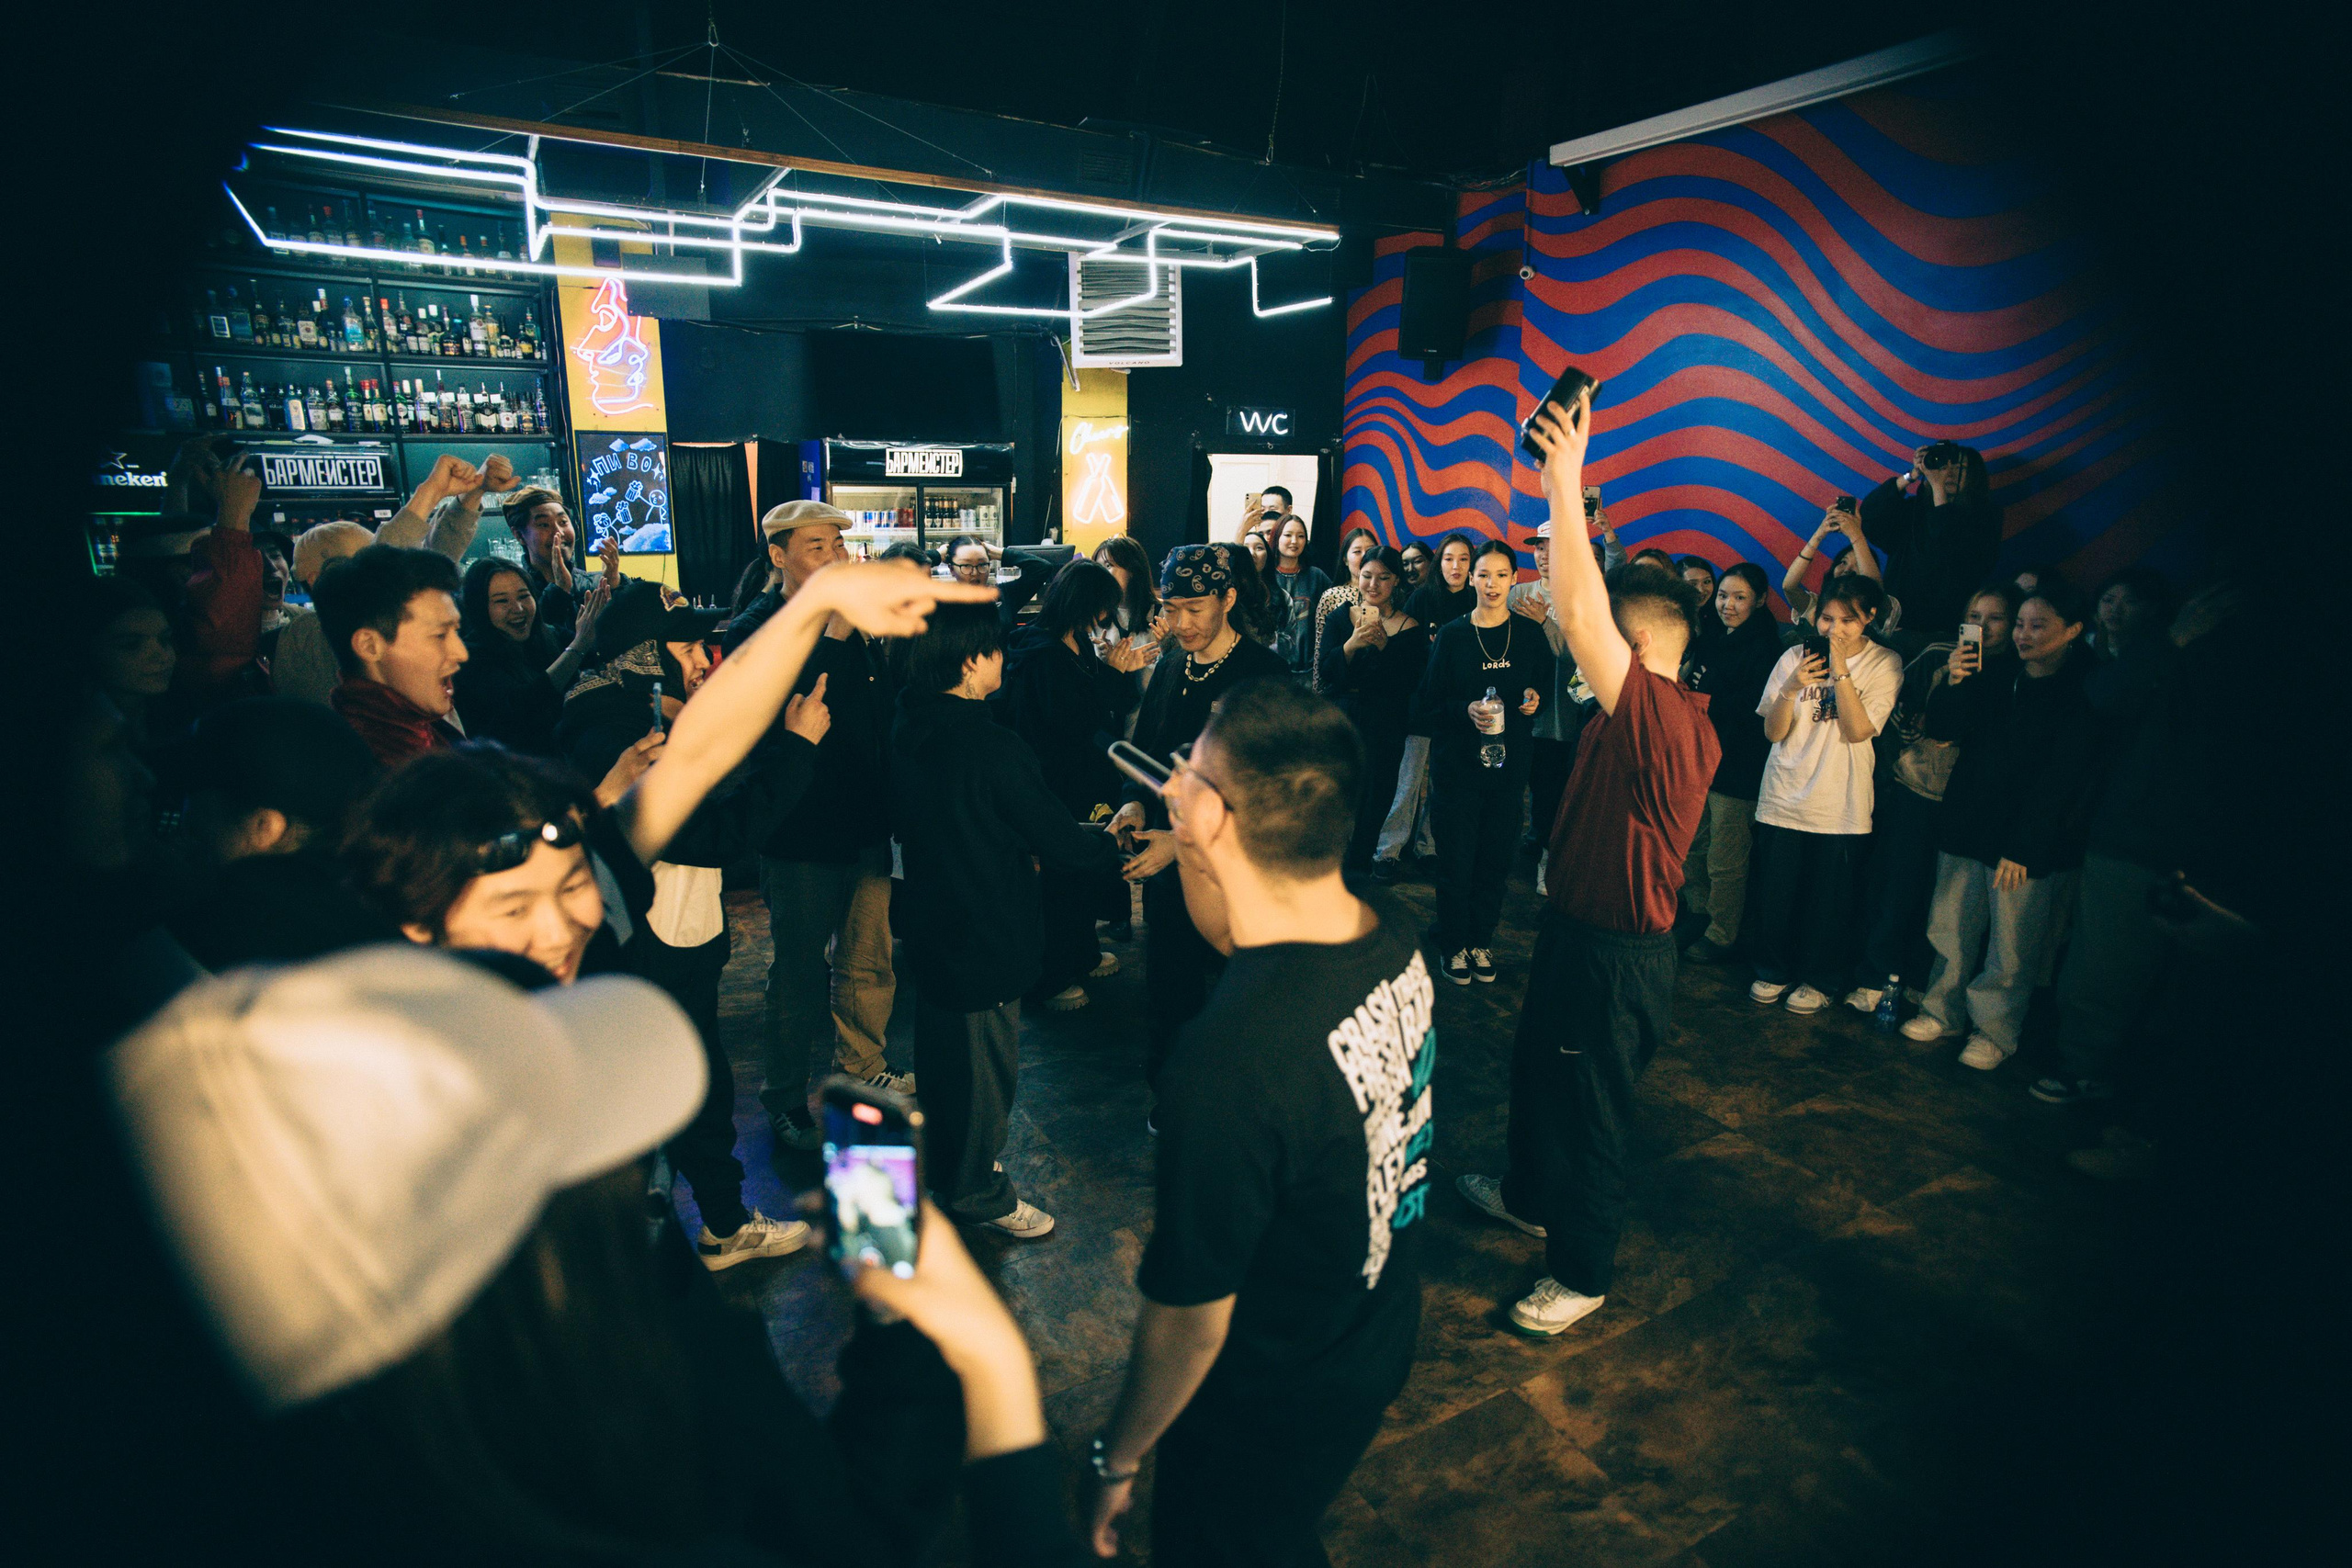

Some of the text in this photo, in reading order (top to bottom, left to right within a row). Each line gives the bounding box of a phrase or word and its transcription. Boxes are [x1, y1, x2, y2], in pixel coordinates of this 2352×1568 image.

[1239, 411, 1288, 435] WC
[262, 455, 378, 486] БАРМЕЙСТЕР
[886, 448, 960, 474] БАРМЕЙСТЕР
